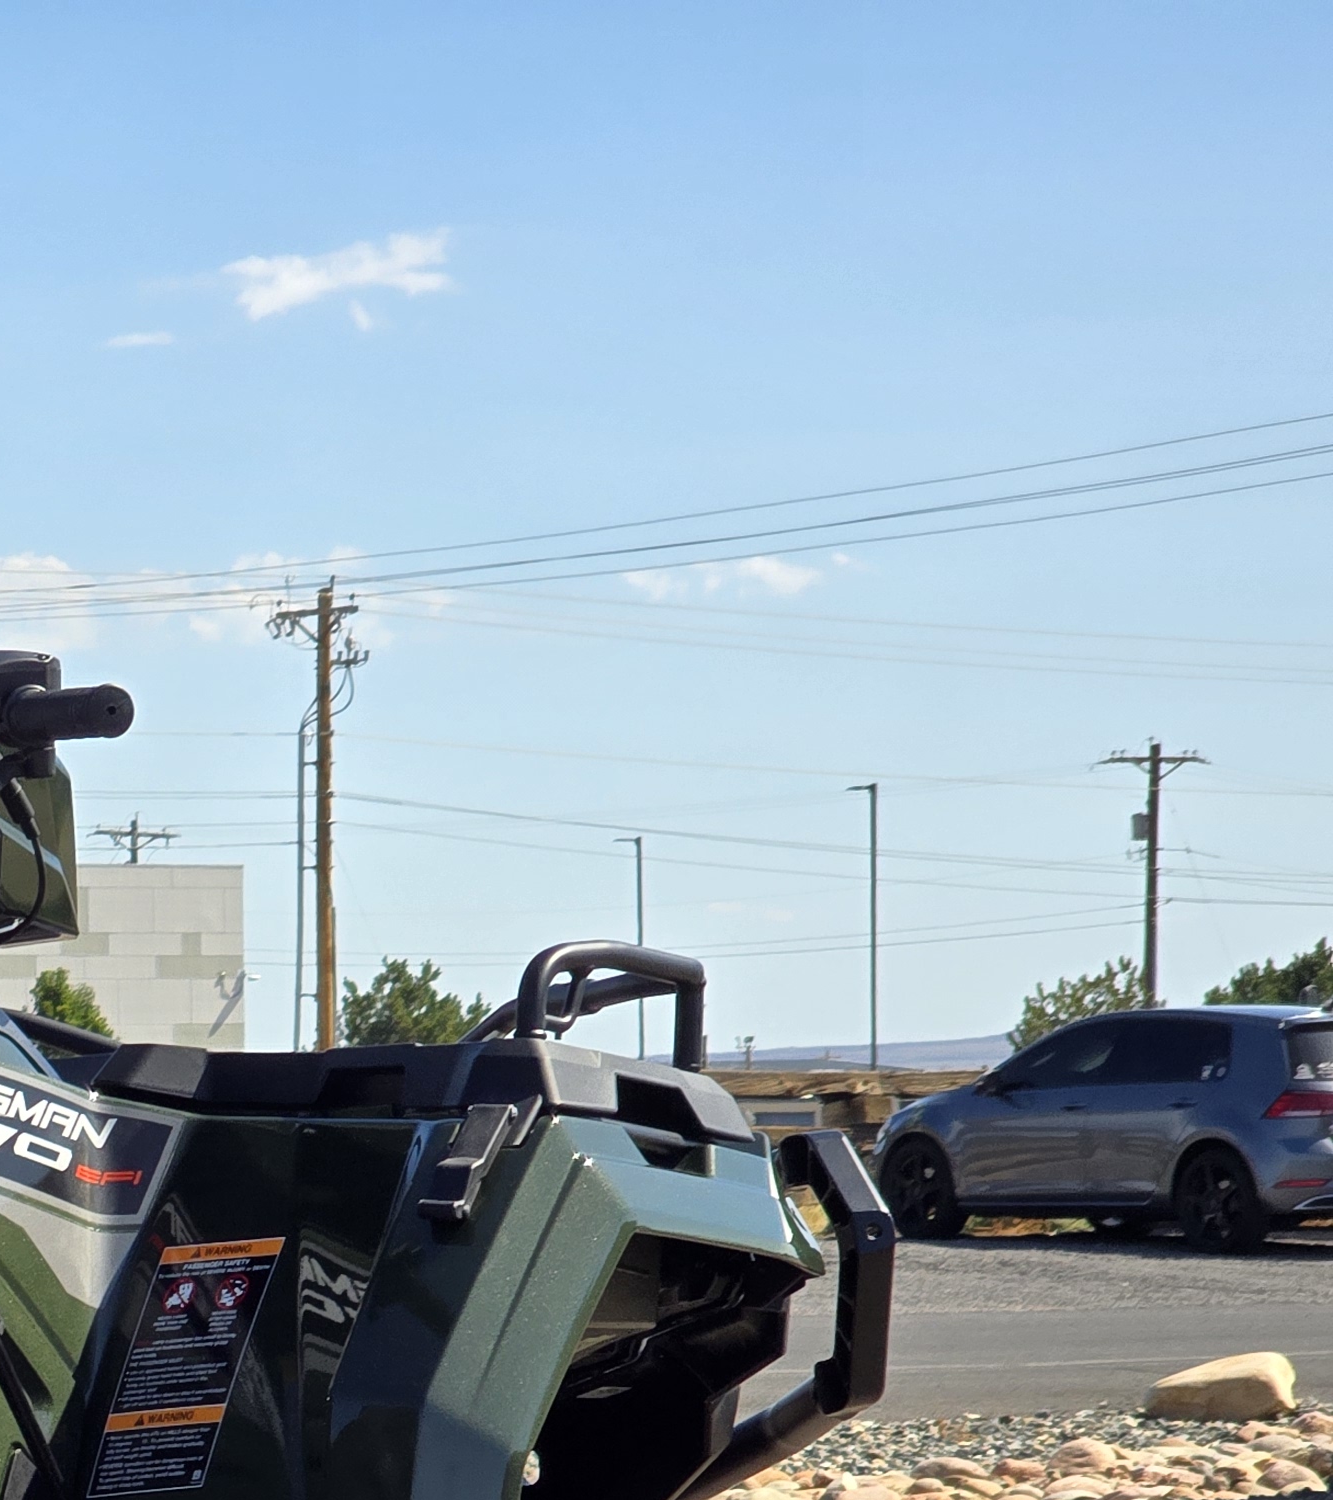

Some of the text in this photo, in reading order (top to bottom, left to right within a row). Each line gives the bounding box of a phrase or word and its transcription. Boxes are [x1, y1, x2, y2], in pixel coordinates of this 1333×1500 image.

[75, 1164, 143, 1186] EFI
[204, 1244, 252, 1257] WARNING
[148, 1410, 195, 1424] WARNING
